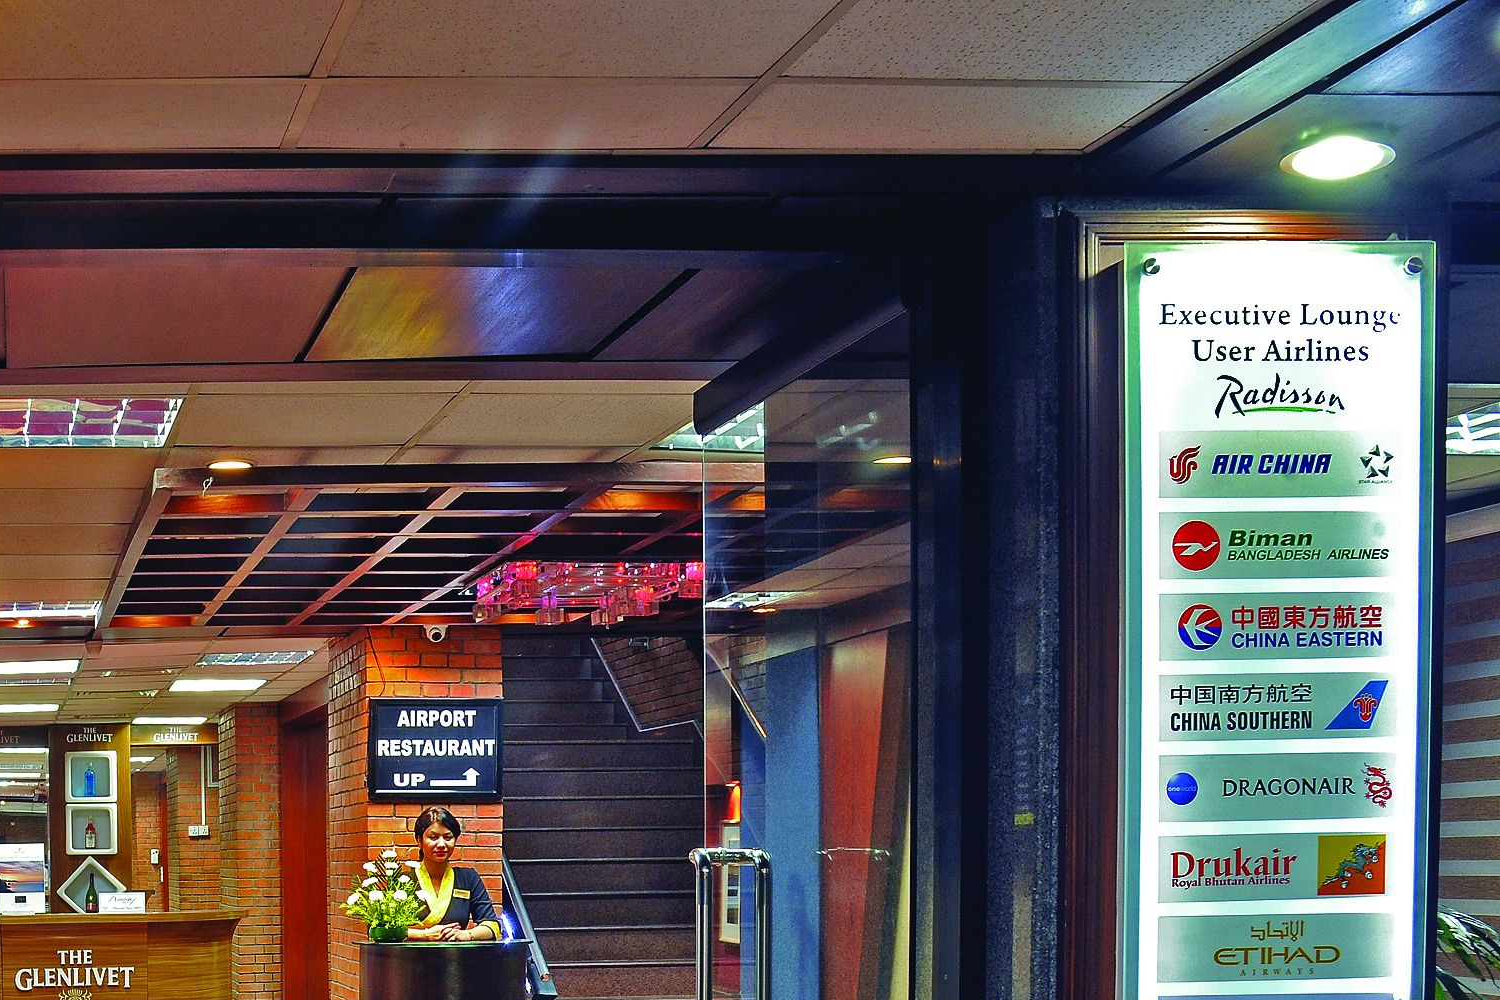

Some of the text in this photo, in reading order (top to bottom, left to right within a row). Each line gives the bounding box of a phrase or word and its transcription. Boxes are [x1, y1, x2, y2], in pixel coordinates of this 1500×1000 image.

[1158, 303, 1291, 326] Executive
[1191, 338, 1369, 362] User Airlines
[1214, 372, 1345, 418] Radisson
[1211, 453, 1332, 475] AIR CHINA
[1228, 529, 1313, 548] Biman
[1227, 548, 1390, 562] BANGLADESH AIRLINES
[1231, 604, 1383, 630] 中國東方航空
[1231, 631, 1383, 648] CHINA EASTERN
[1170, 682, 1313, 706] 中国南方航空
[396, 709, 476, 727] AIRPORT
[1170, 710, 1312, 732] CHINA SOUTHERN
[67, 733, 113, 743] GLENLIVET
[153, 733, 199, 742] GLENLIVET
[377, 739, 495, 757] RESTAURANT
[393, 773, 426, 787] UP
[1222, 778, 1355, 797] DRAGONAIR
[1170, 847, 1297, 878] Drukair
[1171, 875, 1291, 890] Royal Bhutan Airlines
[56, 950, 93, 965] THE
[1213, 945, 1341, 966] ETIHAD
[15, 966, 135, 991] GLENLIVET
[1240, 968, 1315, 977] AIRWAYS
